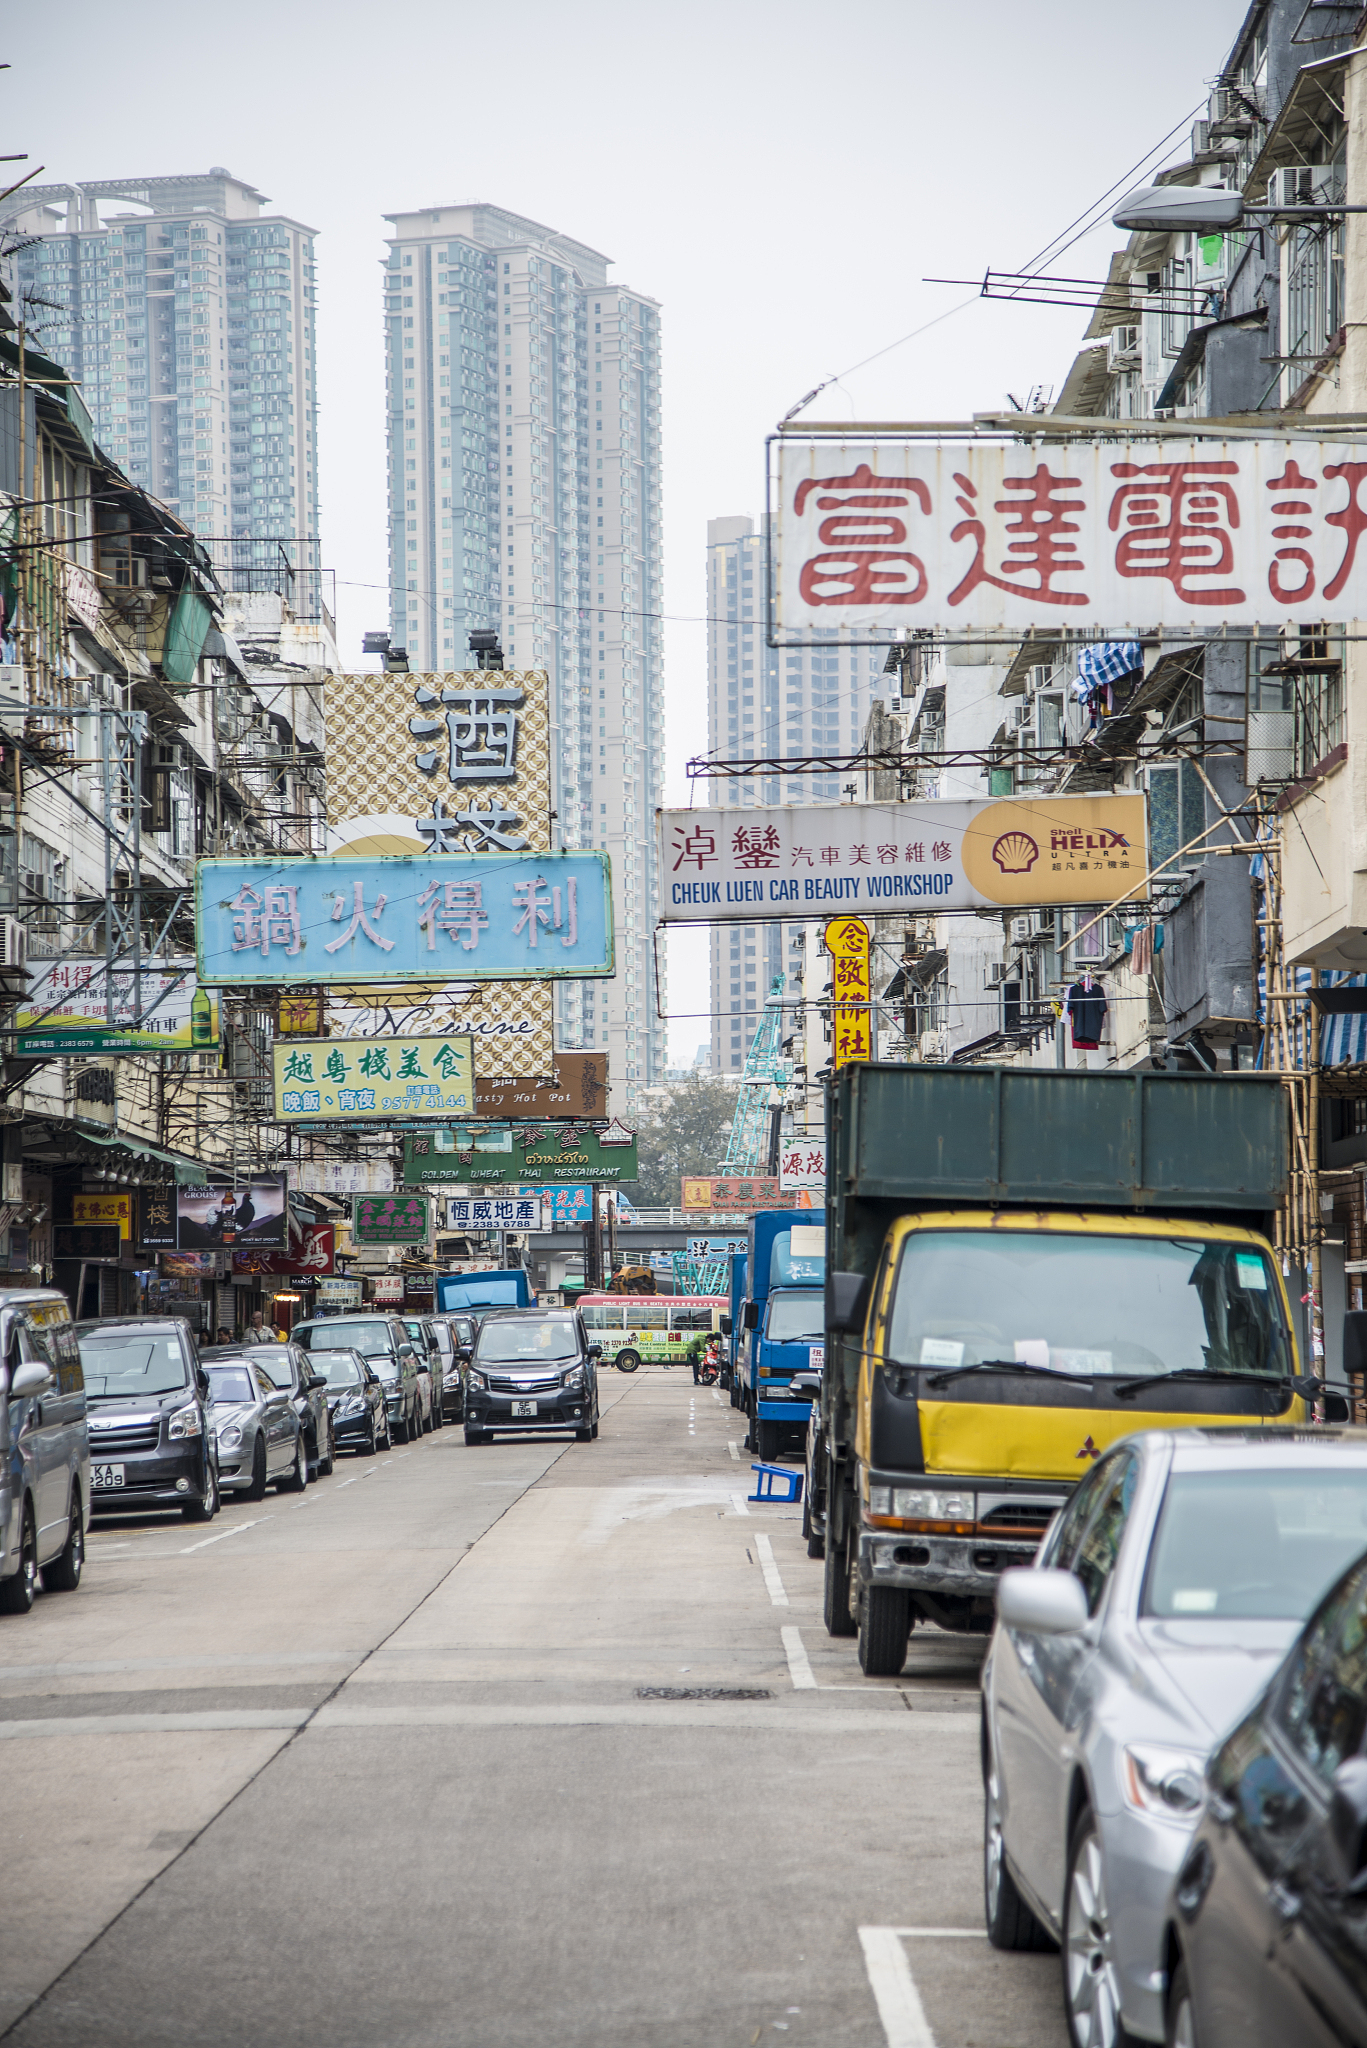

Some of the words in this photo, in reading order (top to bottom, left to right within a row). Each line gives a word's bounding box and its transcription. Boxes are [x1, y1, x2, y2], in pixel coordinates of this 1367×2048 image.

[1050, 828, 1082, 836] Shell
[1050, 828, 1131, 851] HELIX
[791, 840, 953, 868] 汽車美容維修
[1051, 849, 1128, 859] ULTRA
[1051, 860, 1130, 871] 超凡喜力機油
[672, 881, 722, 905] CHEUK
[726, 879, 763, 903] LUEN
[769, 878, 799, 902] CAR
[804, 876, 860, 900] BEAUTY
[867, 873, 954, 898] WORKSHOP
[382, 1096, 423, 1110] 9577
[425, 1094, 466, 1108] 4144
[476, 1093, 504, 1106] asty
[513, 1092, 537, 1103] Hot
[548, 1092, 571, 1102] Pot
[420, 1169, 459, 1180] GOLDEN
[470, 1168, 506, 1179] WHEAT
[518, 1168, 542, 1179] THAI
[553, 1166, 621, 1178] RESTAURANT
[183, 1191, 219, 1199] GROUSE
[503, 1220, 530, 1228] 6788
[518, 1401, 530, 1409] SF
[517, 1407, 532, 1416] 195
[94, 1465, 113, 1477] KA
